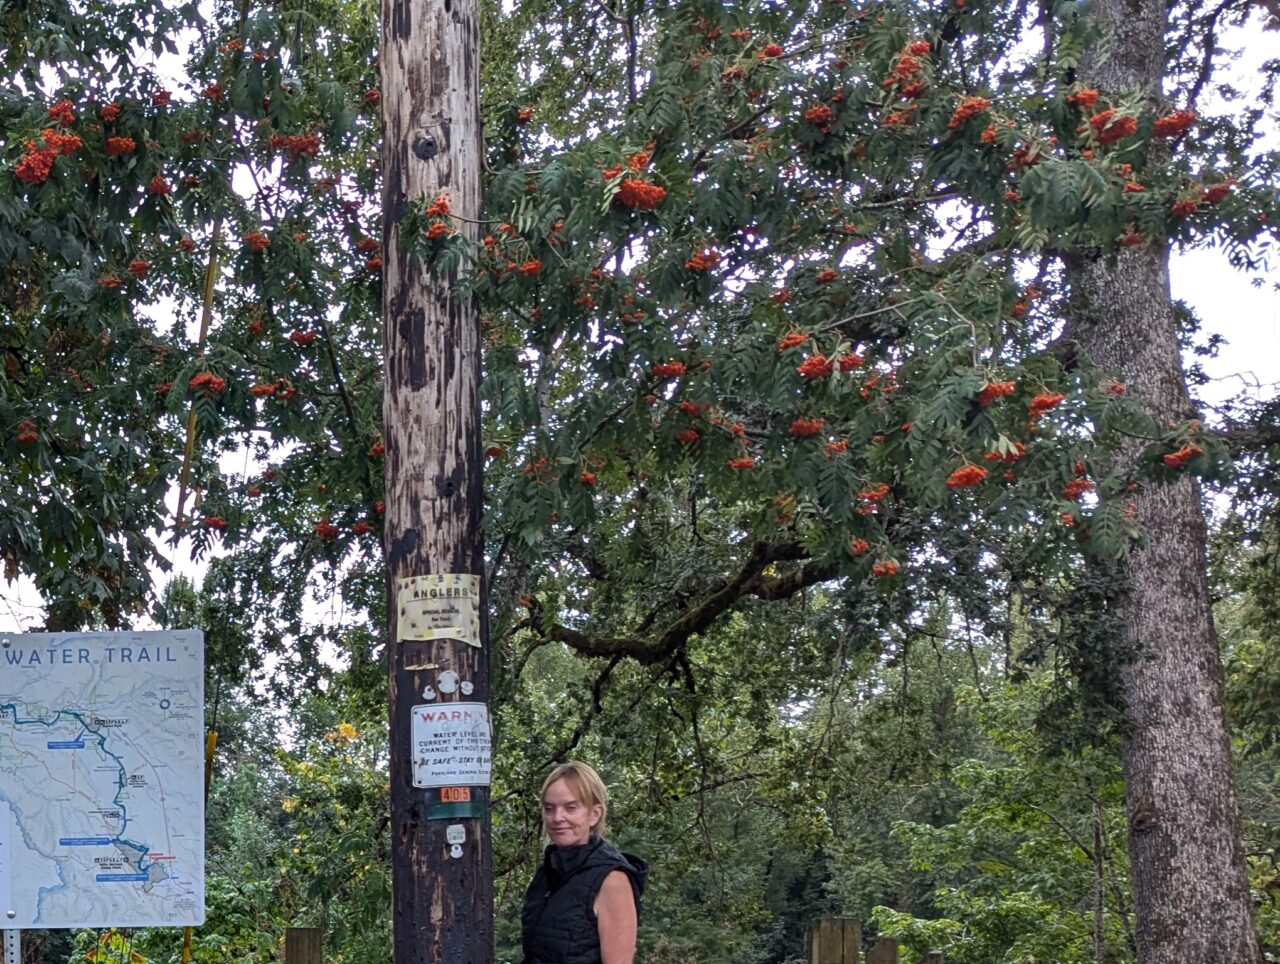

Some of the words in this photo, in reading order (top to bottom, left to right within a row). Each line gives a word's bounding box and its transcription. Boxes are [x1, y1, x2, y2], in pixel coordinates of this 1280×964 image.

[413, 588, 468, 599] ANGLERS
[5, 648, 90, 666] WATER
[105, 647, 177, 664] TRAIL
[418, 739, 451, 747] CURRENT
[420, 746, 449, 754] CHANGE
[443, 789, 469, 800] 405
